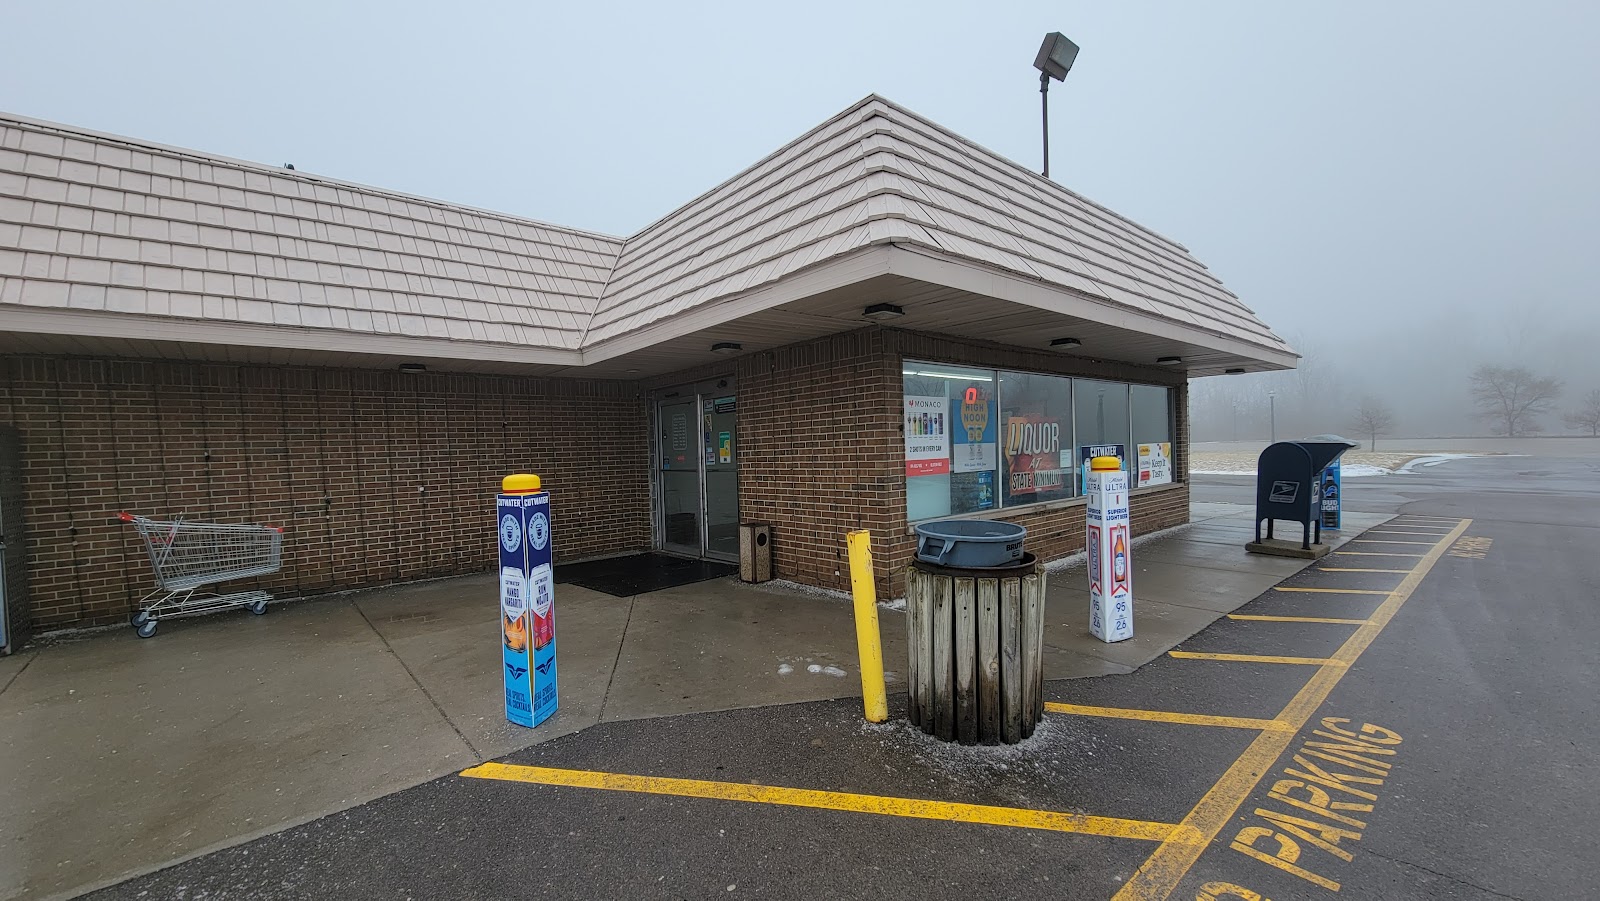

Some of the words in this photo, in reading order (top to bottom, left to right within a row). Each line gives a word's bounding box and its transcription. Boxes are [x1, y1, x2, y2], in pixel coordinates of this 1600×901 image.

[964, 412, 986, 422] NOON
[1009, 422, 1060, 456] LIQUOR
[1090, 446, 1117, 457] CUTWATER
[1029, 458, 1042, 469] AT
[1152, 460, 1162, 468] Keep
[1012, 472, 1031, 490] STATE
[1033, 470, 1060, 488] MINIMUM
[1152, 470, 1164, 479] Tasty.
[1106, 482, 1126, 491] ULTRA
[524, 496, 548, 506] CUTWATER
[1006, 540, 1023, 551] BRUTE
[506, 587, 519, 598] MANGO
[538, 584, 546, 595] RUM
[504, 596, 522, 609] MARGARITA
[536, 592, 548, 606] MOJITO
[1116, 601, 1126, 612] 95
[1229, 716, 1404, 892] PARKING
